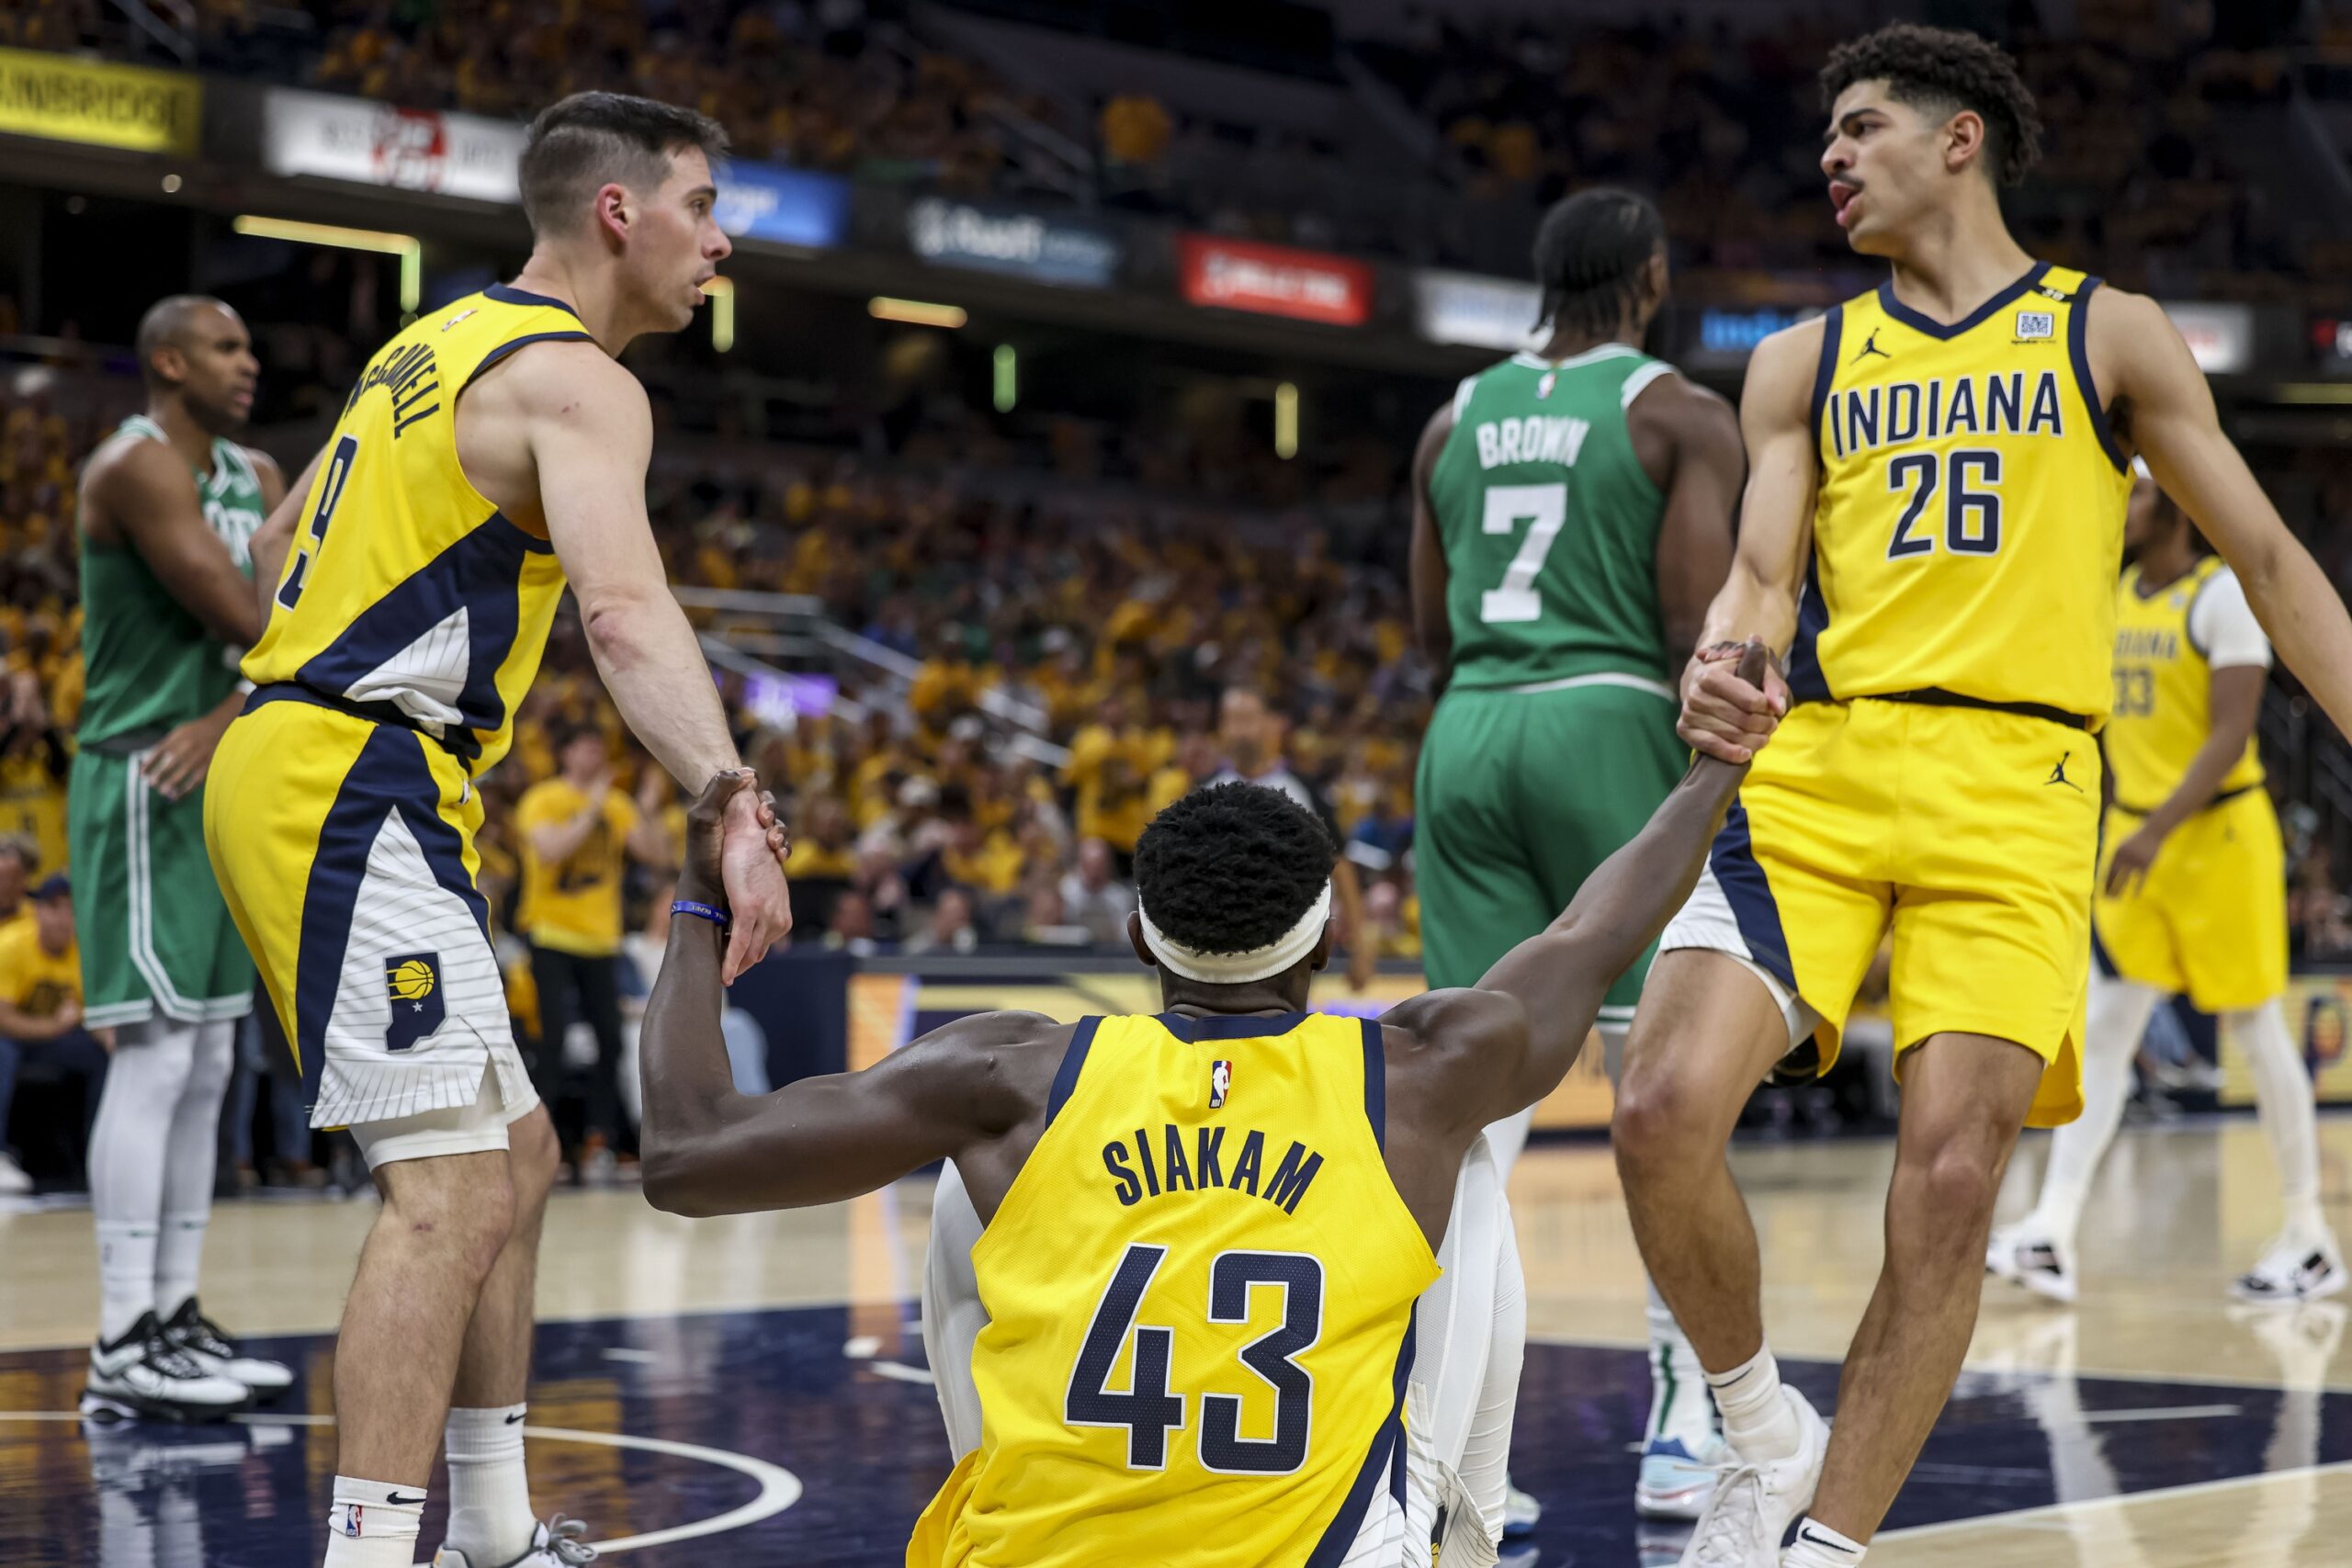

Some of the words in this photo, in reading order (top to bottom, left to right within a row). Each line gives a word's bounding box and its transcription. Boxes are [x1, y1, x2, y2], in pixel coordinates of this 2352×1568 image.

[1476, 415, 1589, 469] BROWN
[1829, 370, 2064, 460] INDIANA
[275, 434, 359, 613] 9
[1481, 482, 1567, 624] 7
[1886, 447, 2003, 560] 26
[1102, 1123, 1325, 1216] SIAKAM
[1066, 1243, 1325, 1474] 43
